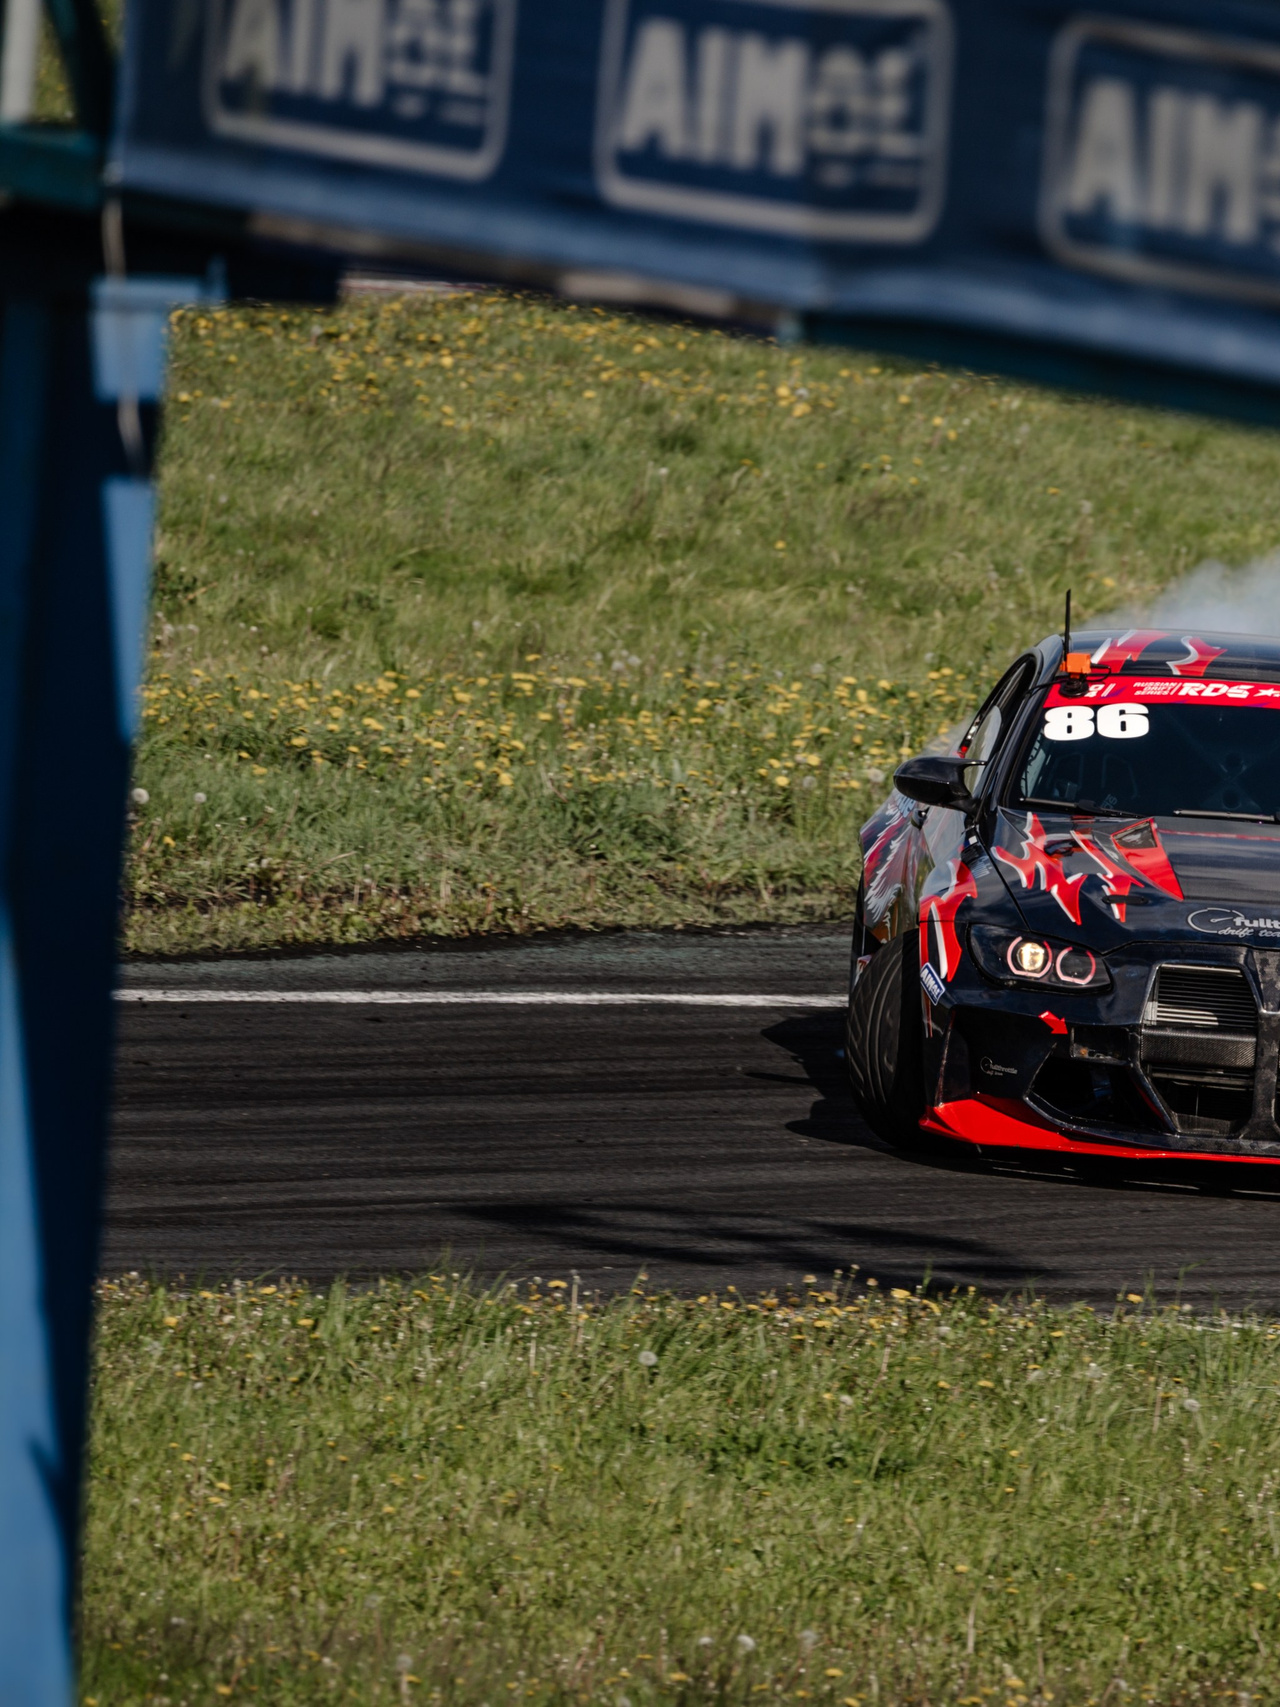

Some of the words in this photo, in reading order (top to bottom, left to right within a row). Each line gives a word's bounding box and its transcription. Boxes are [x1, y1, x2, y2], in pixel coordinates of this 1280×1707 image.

[621, 18, 924, 183] AIMOL
[1179, 682, 1254, 698] RDS
[1044, 702, 1149, 741] 86
[1217, 927, 1254, 938] drift
